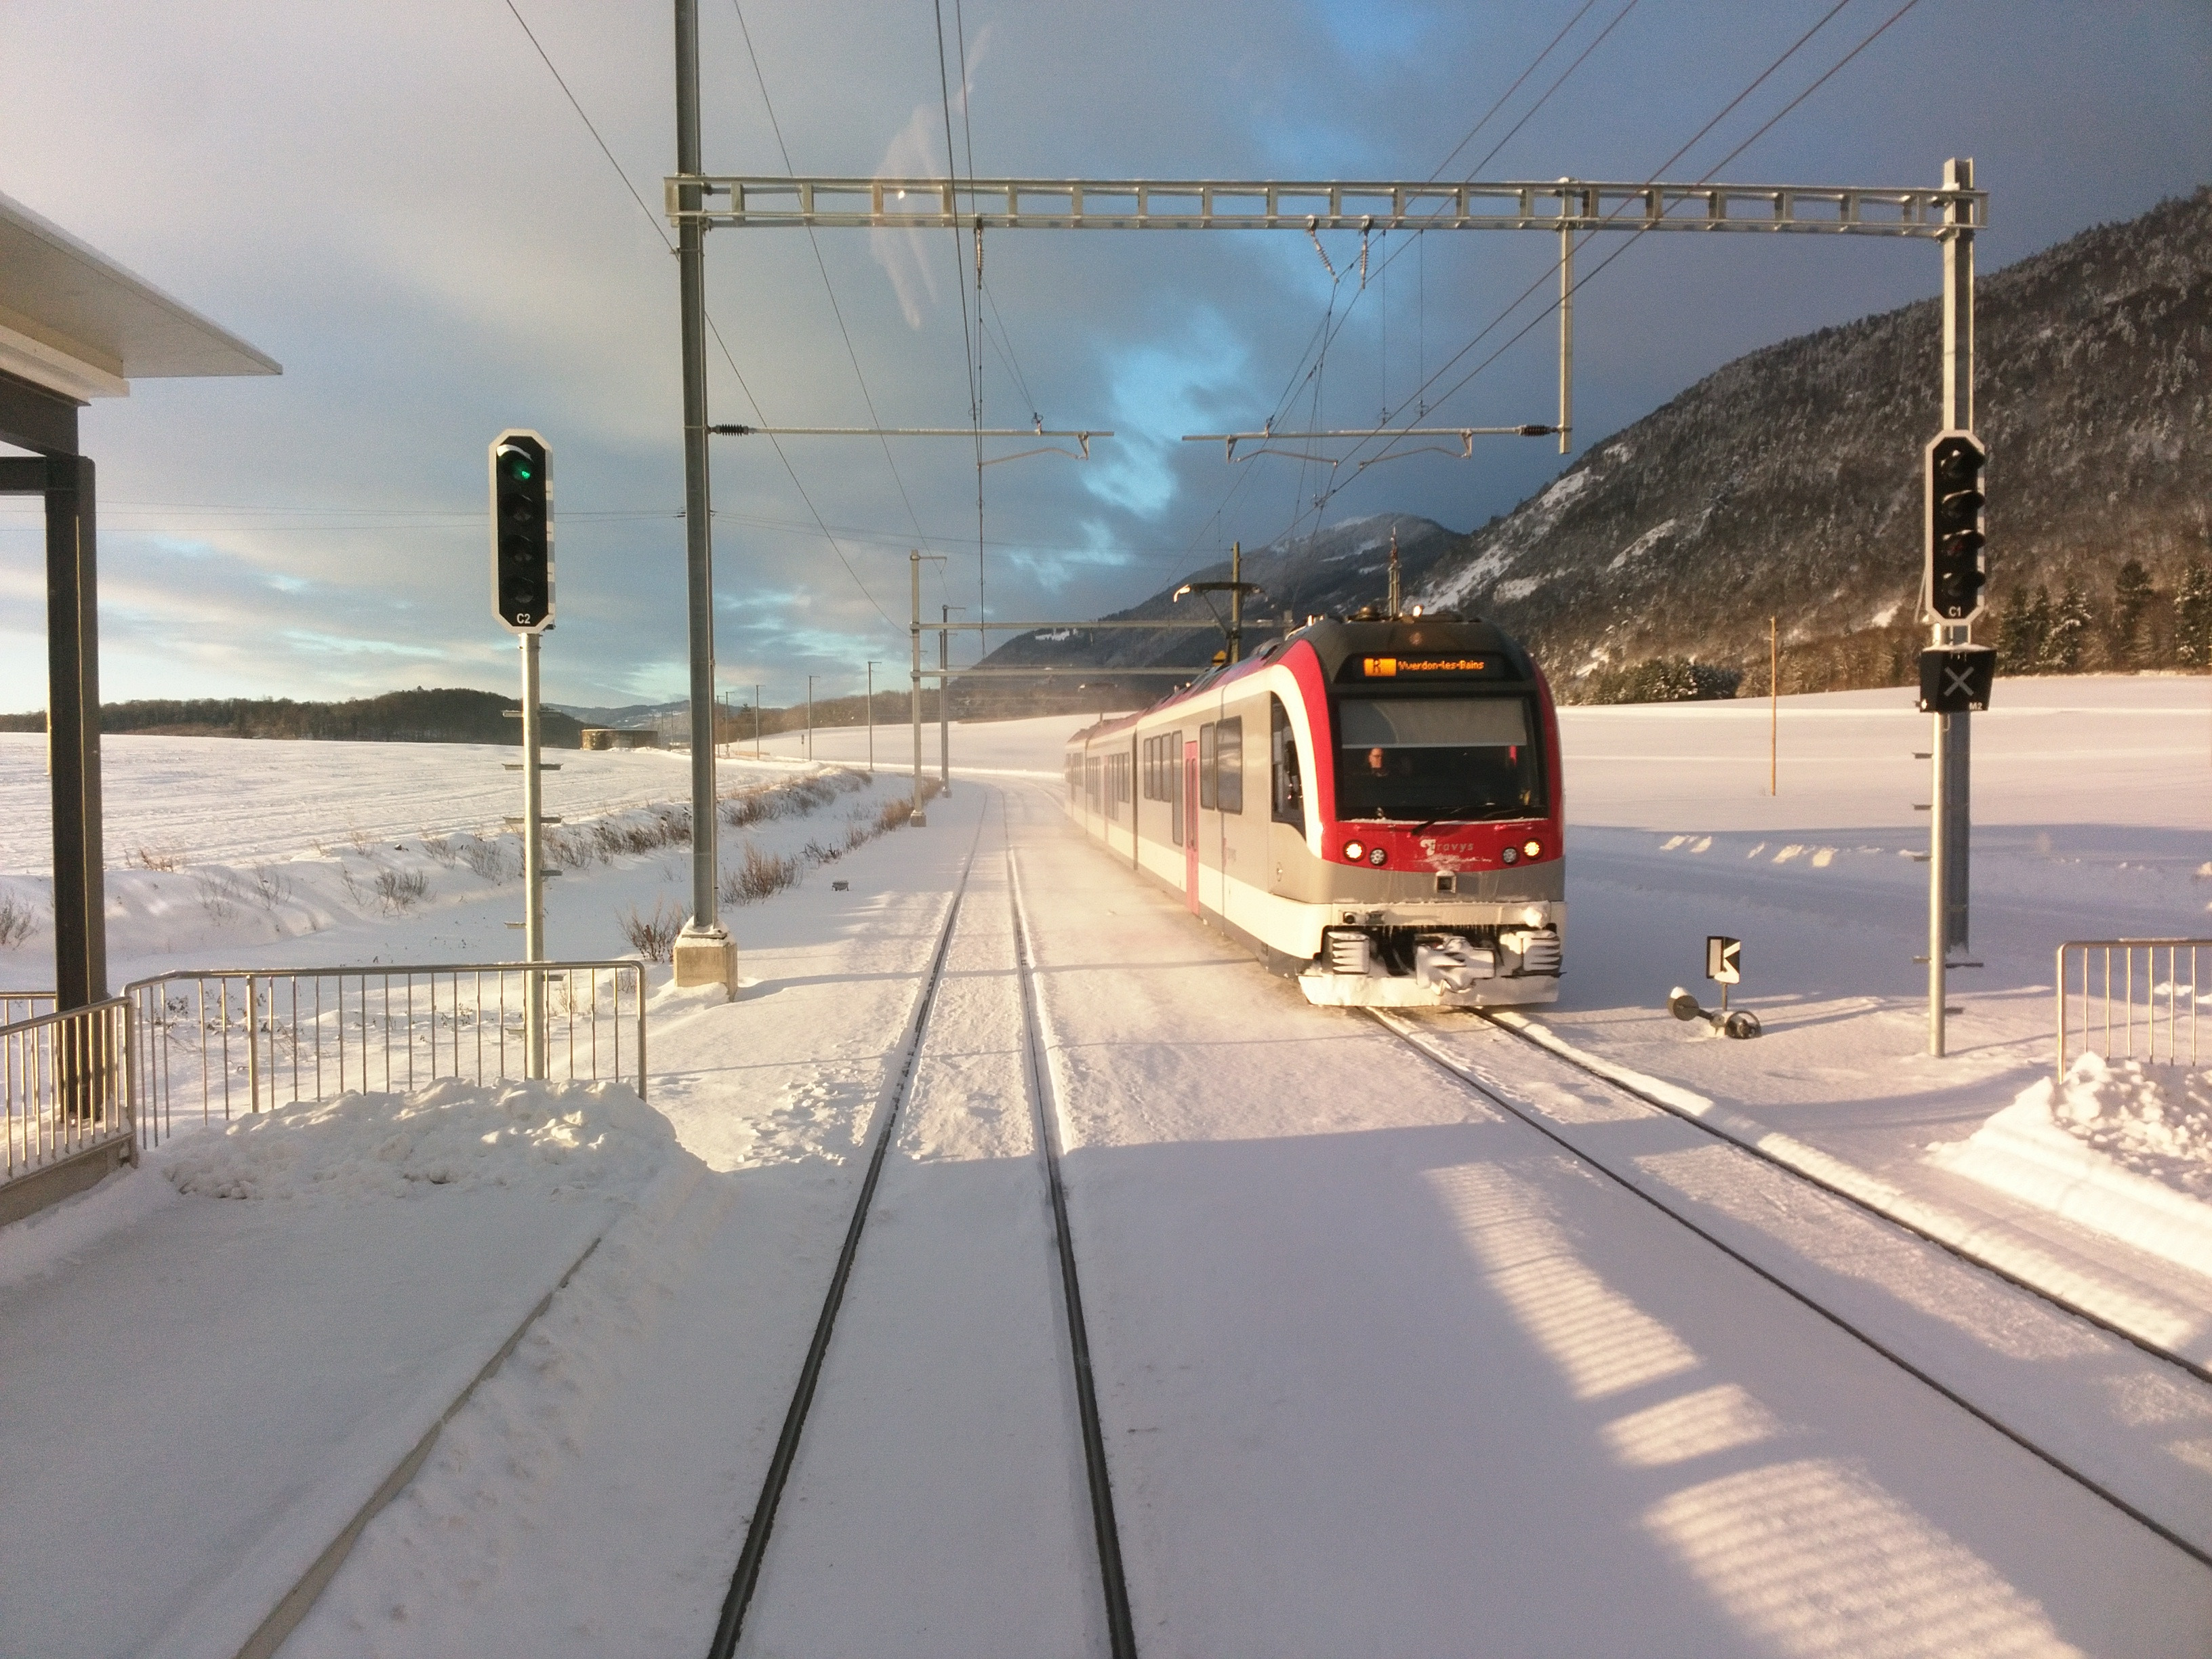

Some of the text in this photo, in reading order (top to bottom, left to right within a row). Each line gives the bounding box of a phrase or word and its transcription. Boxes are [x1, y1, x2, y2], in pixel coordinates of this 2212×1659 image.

[1948, 606, 1962, 617] C1
[516, 613, 531, 624] C2
[1969, 701, 1983, 711] M2
